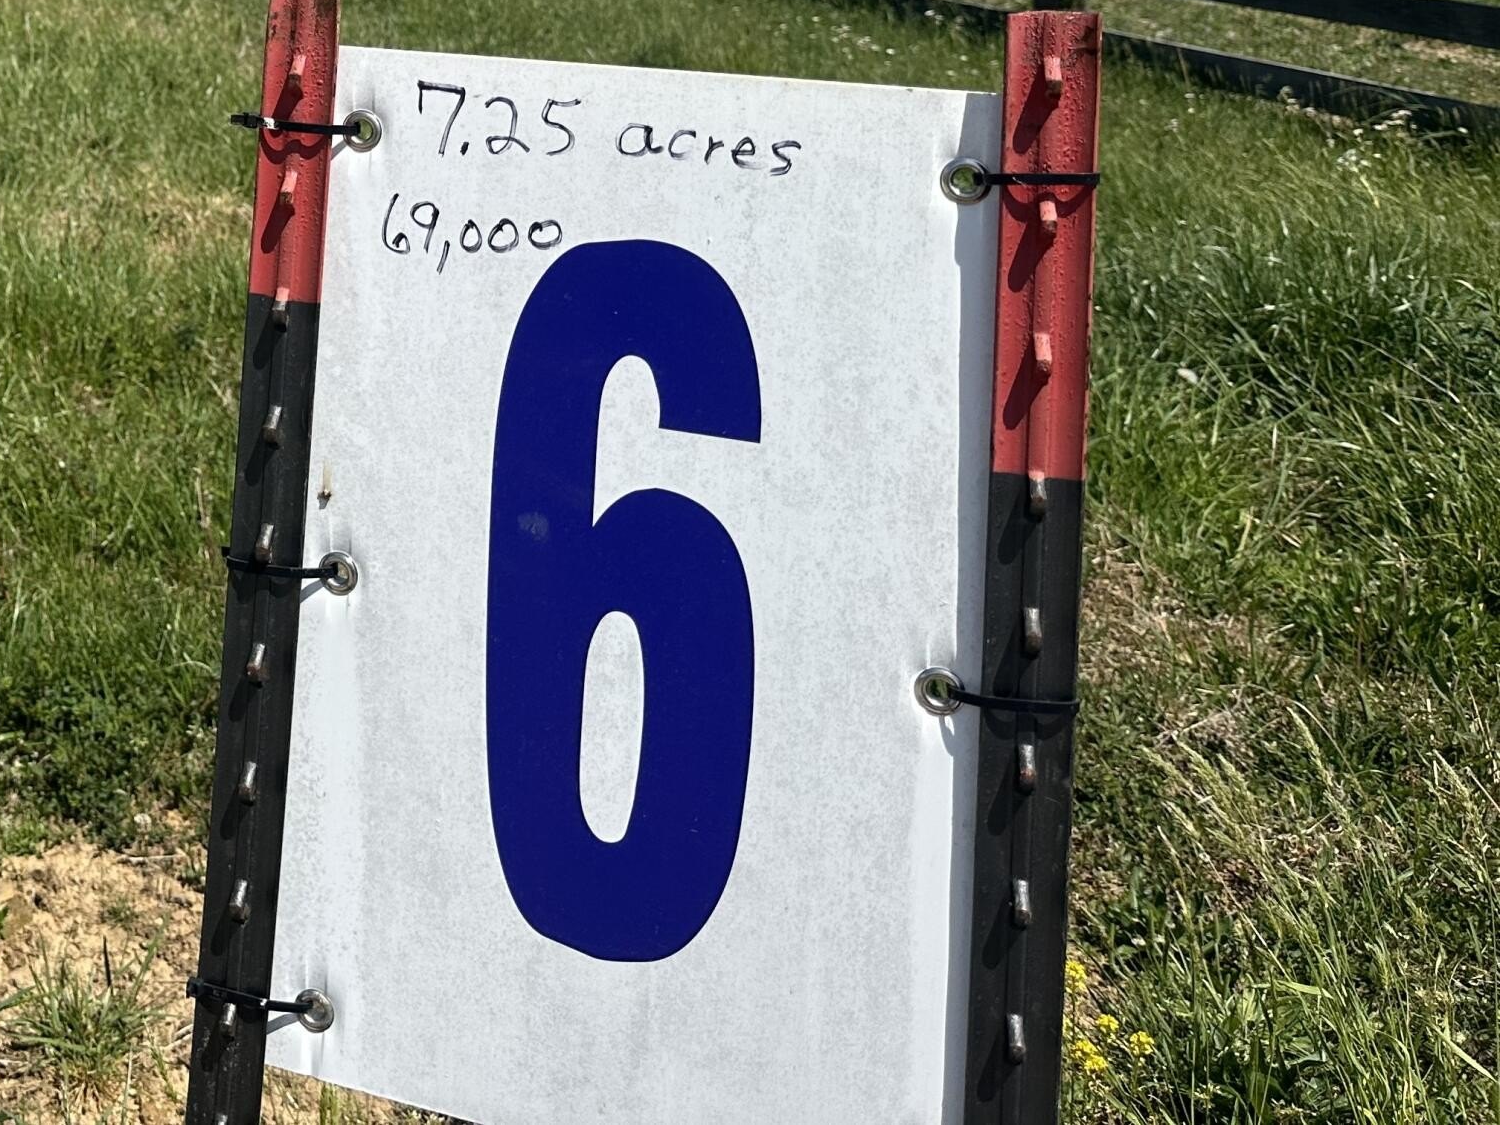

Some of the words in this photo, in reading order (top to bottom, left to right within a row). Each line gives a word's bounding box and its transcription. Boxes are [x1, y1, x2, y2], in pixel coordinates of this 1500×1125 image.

[416, 79, 582, 157] 7.25
[614, 121, 802, 177] acres
[380, 193, 564, 274] 69,000
[485, 239, 762, 962] 6
